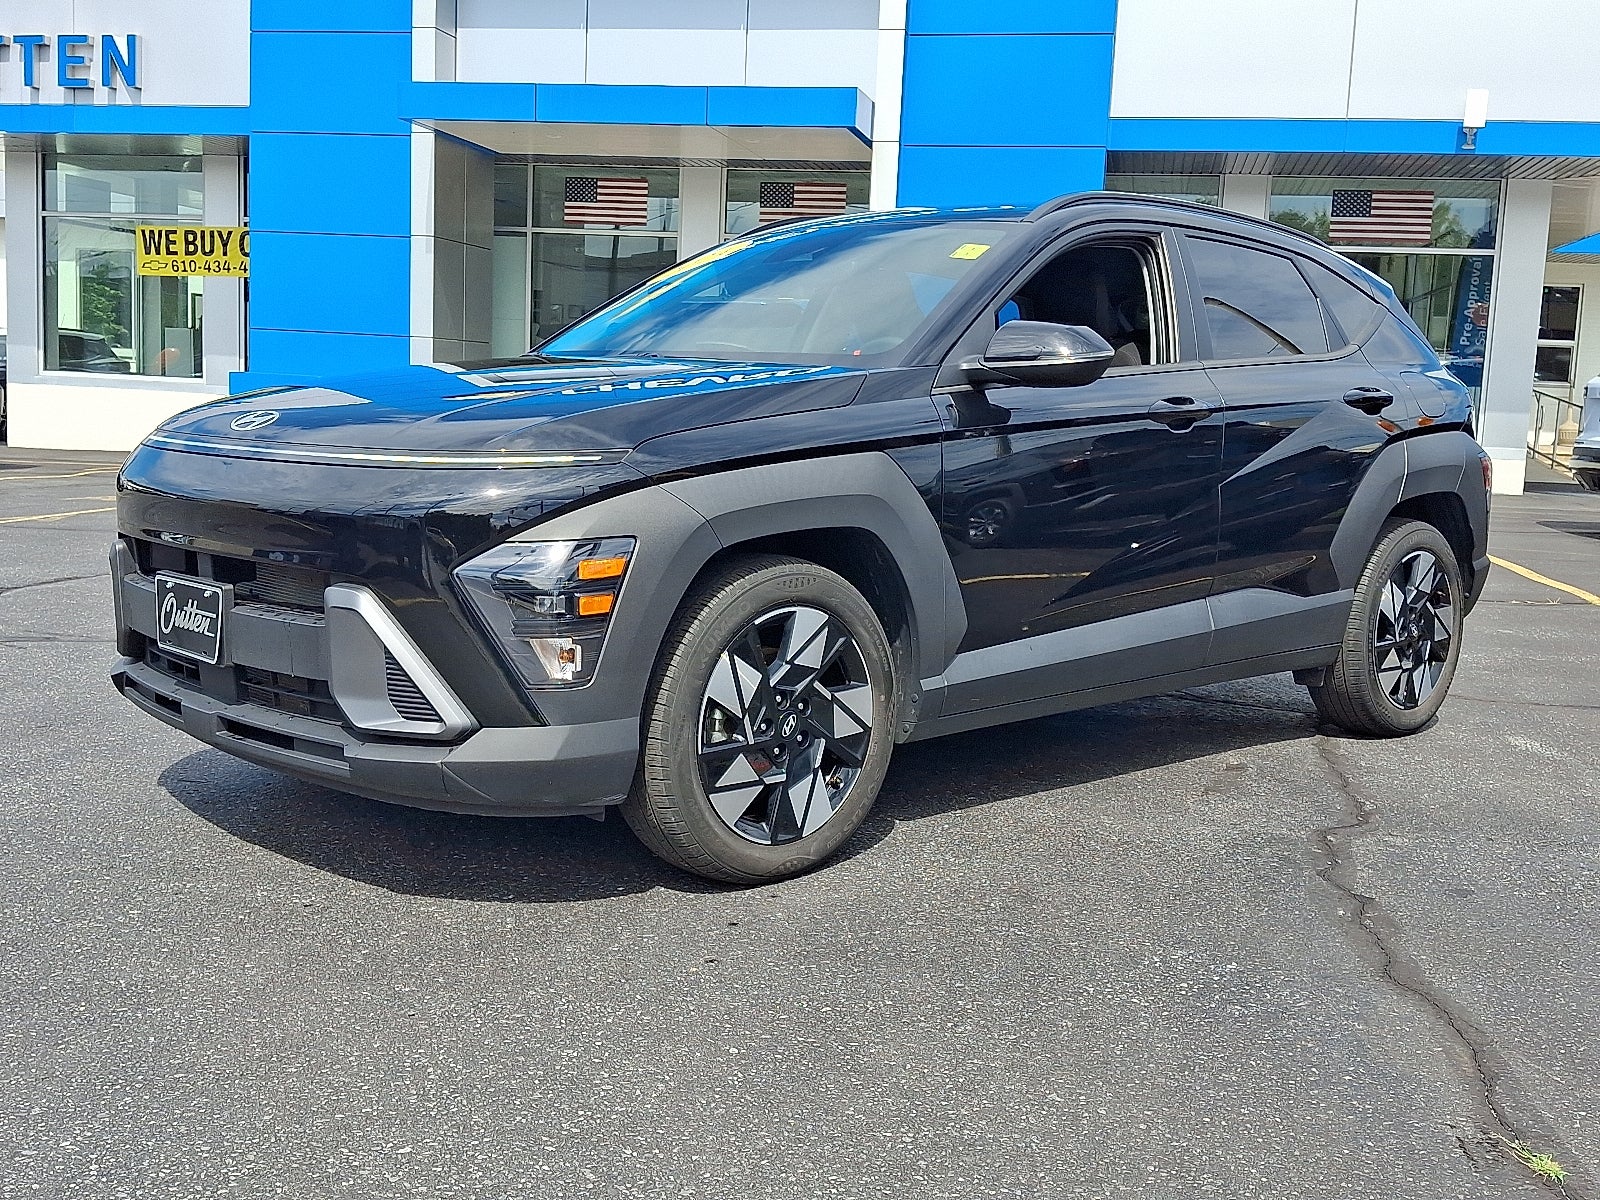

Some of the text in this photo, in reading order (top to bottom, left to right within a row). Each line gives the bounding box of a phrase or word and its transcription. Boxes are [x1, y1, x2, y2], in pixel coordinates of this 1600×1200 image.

[0, 34, 141, 89] TEN
[140, 229, 179, 256] WE
[183, 229, 234, 257] BUY
[171, 259, 249, 273] 610-434-4
[1459, 256, 1483, 346] Pre-Approval
[160, 592, 217, 638] Outten
